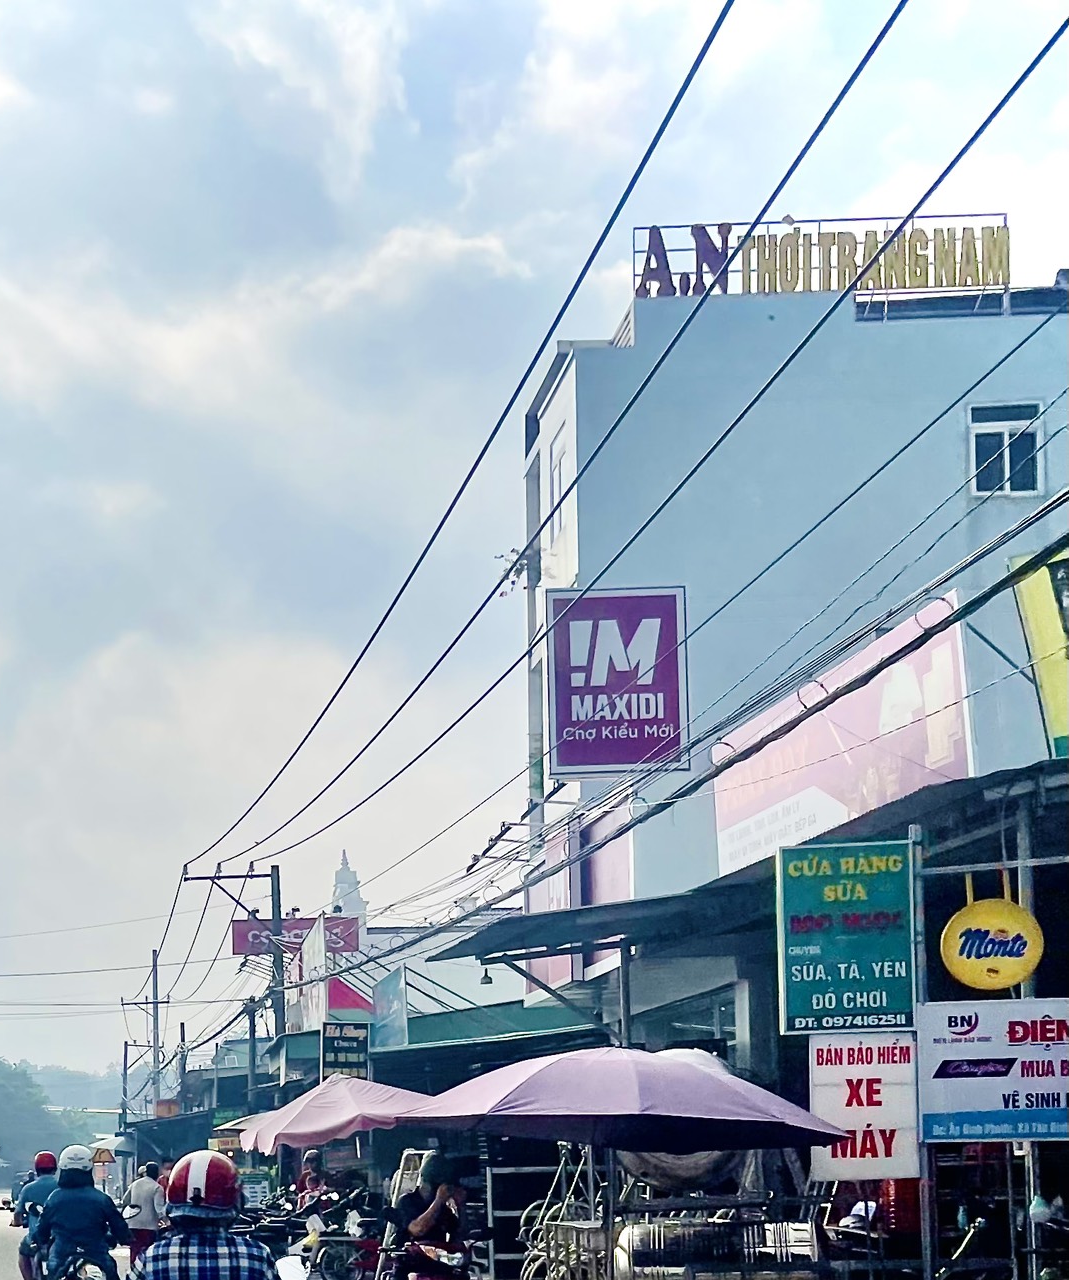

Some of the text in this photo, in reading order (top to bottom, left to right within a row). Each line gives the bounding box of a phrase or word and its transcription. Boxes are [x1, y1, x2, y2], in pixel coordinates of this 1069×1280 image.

[636, 222, 732, 297] A.N
[818, 227, 929, 292] TRANG
[934, 226, 1010, 287] NAM
[571, 692, 665, 722] MAXIDI
[602, 722, 638, 740] Kiểu
[644, 723, 675, 738] Mới
[788, 852, 903, 877] CỬA HÀNG
[959, 927, 1028, 960] Monte
[842, 989, 888, 1009] CHƠI
[948, 1015, 973, 1028] BN
[816, 1038, 911, 1066] BÁN BẢO HIỂM
[1021, 1059, 1055, 1077] MUA
[845, 1078, 882, 1107] XE
[1025, 1092, 1061, 1109] SINH
[831, 1123, 896, 1158] MÁY
